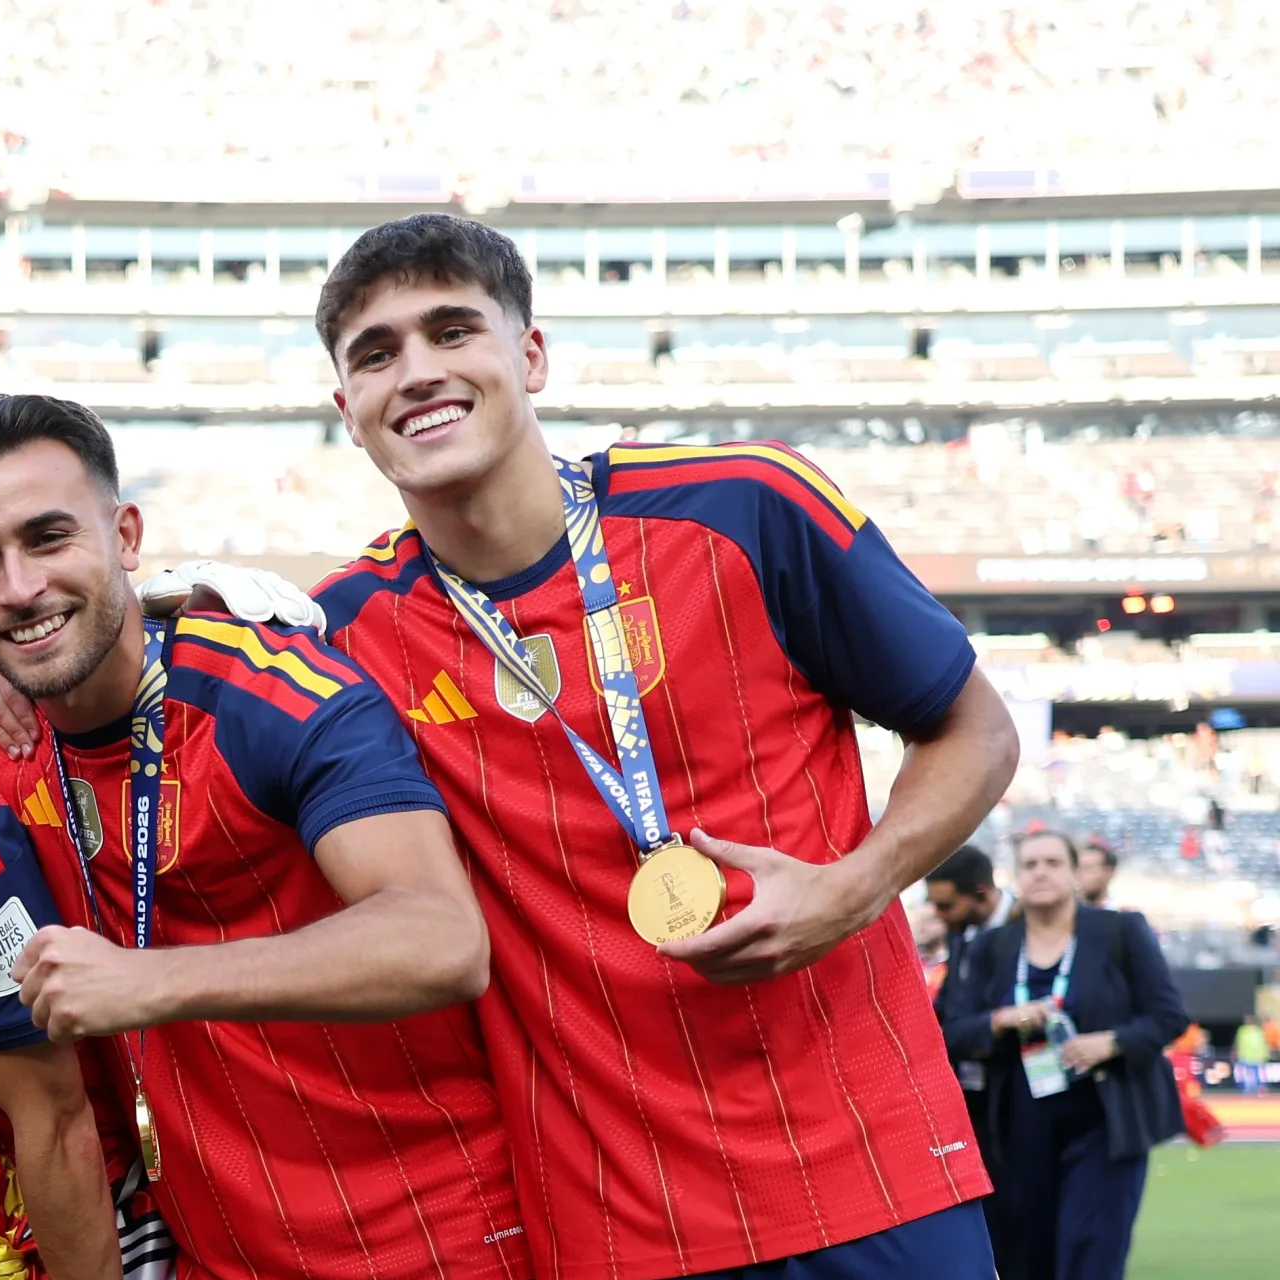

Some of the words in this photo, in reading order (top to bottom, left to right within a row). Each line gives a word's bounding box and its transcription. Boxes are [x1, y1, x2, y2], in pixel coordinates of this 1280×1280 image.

[576, 742, 603, 774] FIFA
[633, 770, 653, 812] FIFA
[137, 796, 150, 859] 2026
[137, 862, 147, 897] CUP
[138, 900, 146, 949] ORLD
[483, 1225, 524, 1245] CLIMACOOL
